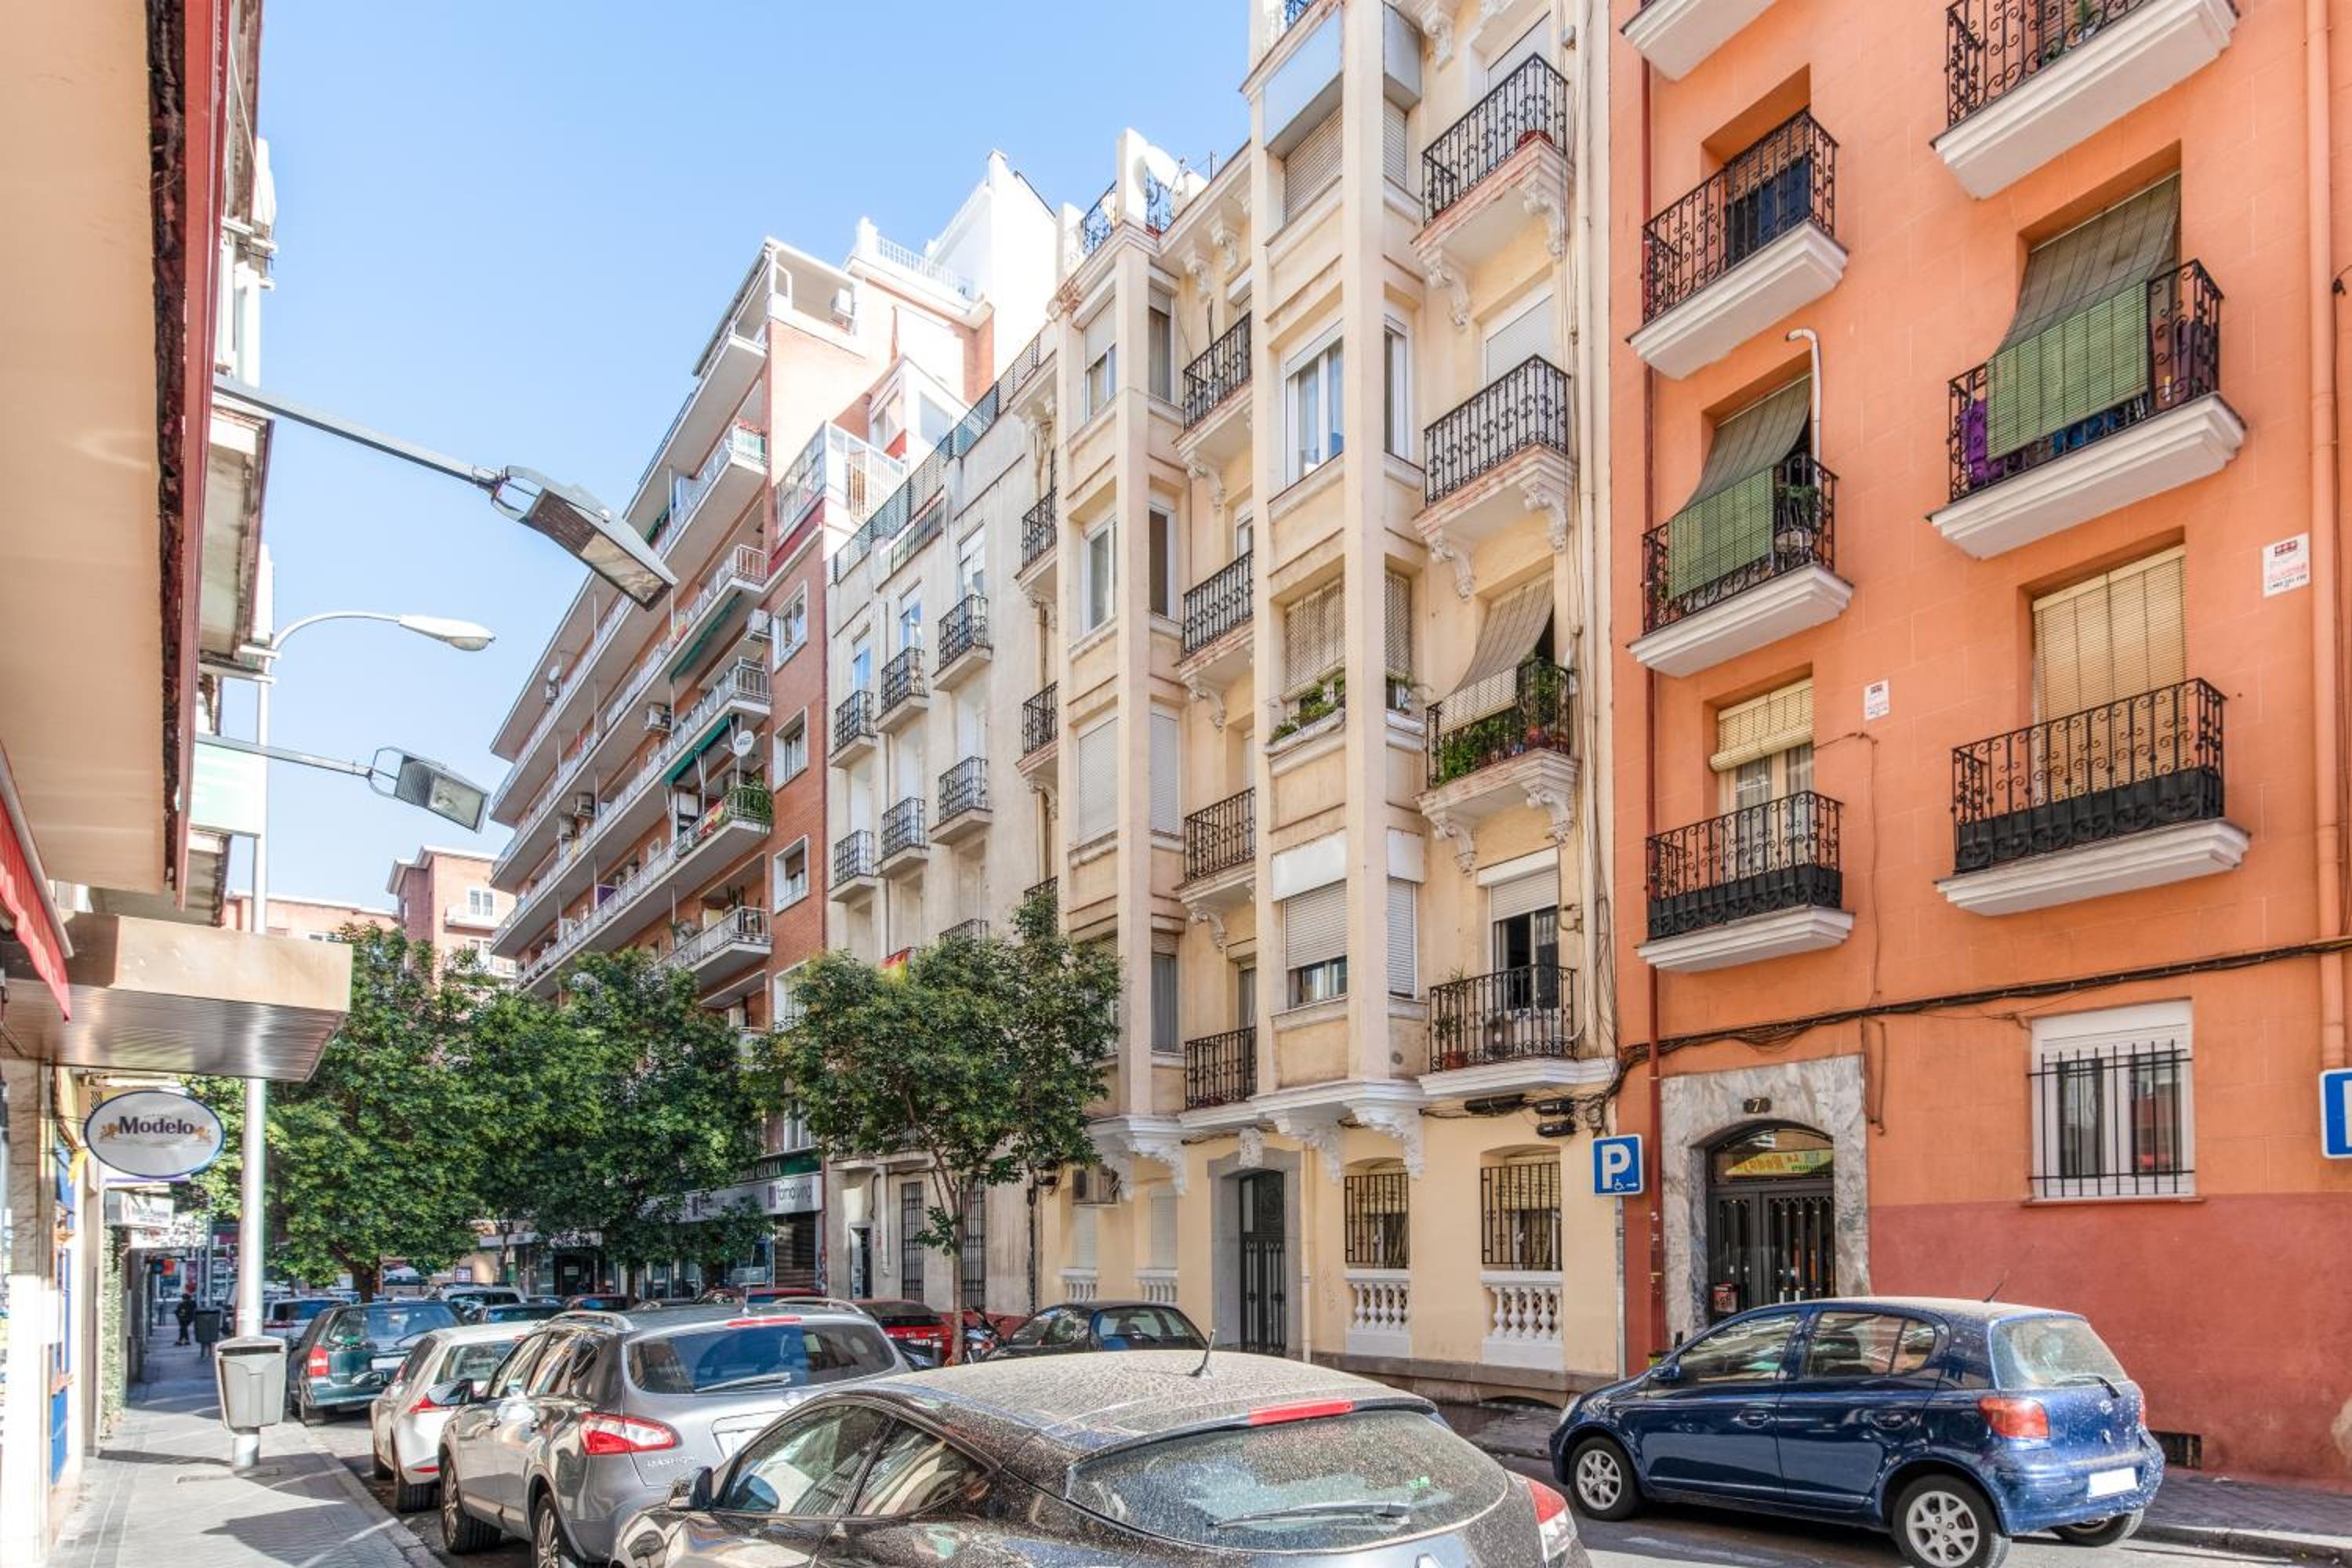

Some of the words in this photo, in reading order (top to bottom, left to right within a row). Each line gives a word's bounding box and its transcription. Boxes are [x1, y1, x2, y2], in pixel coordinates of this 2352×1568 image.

[1753, 1098, 1761, 1112] 7
[118, 1116, 194, 1134] Modelo
[1602, 1144, 1632, 1189] P
